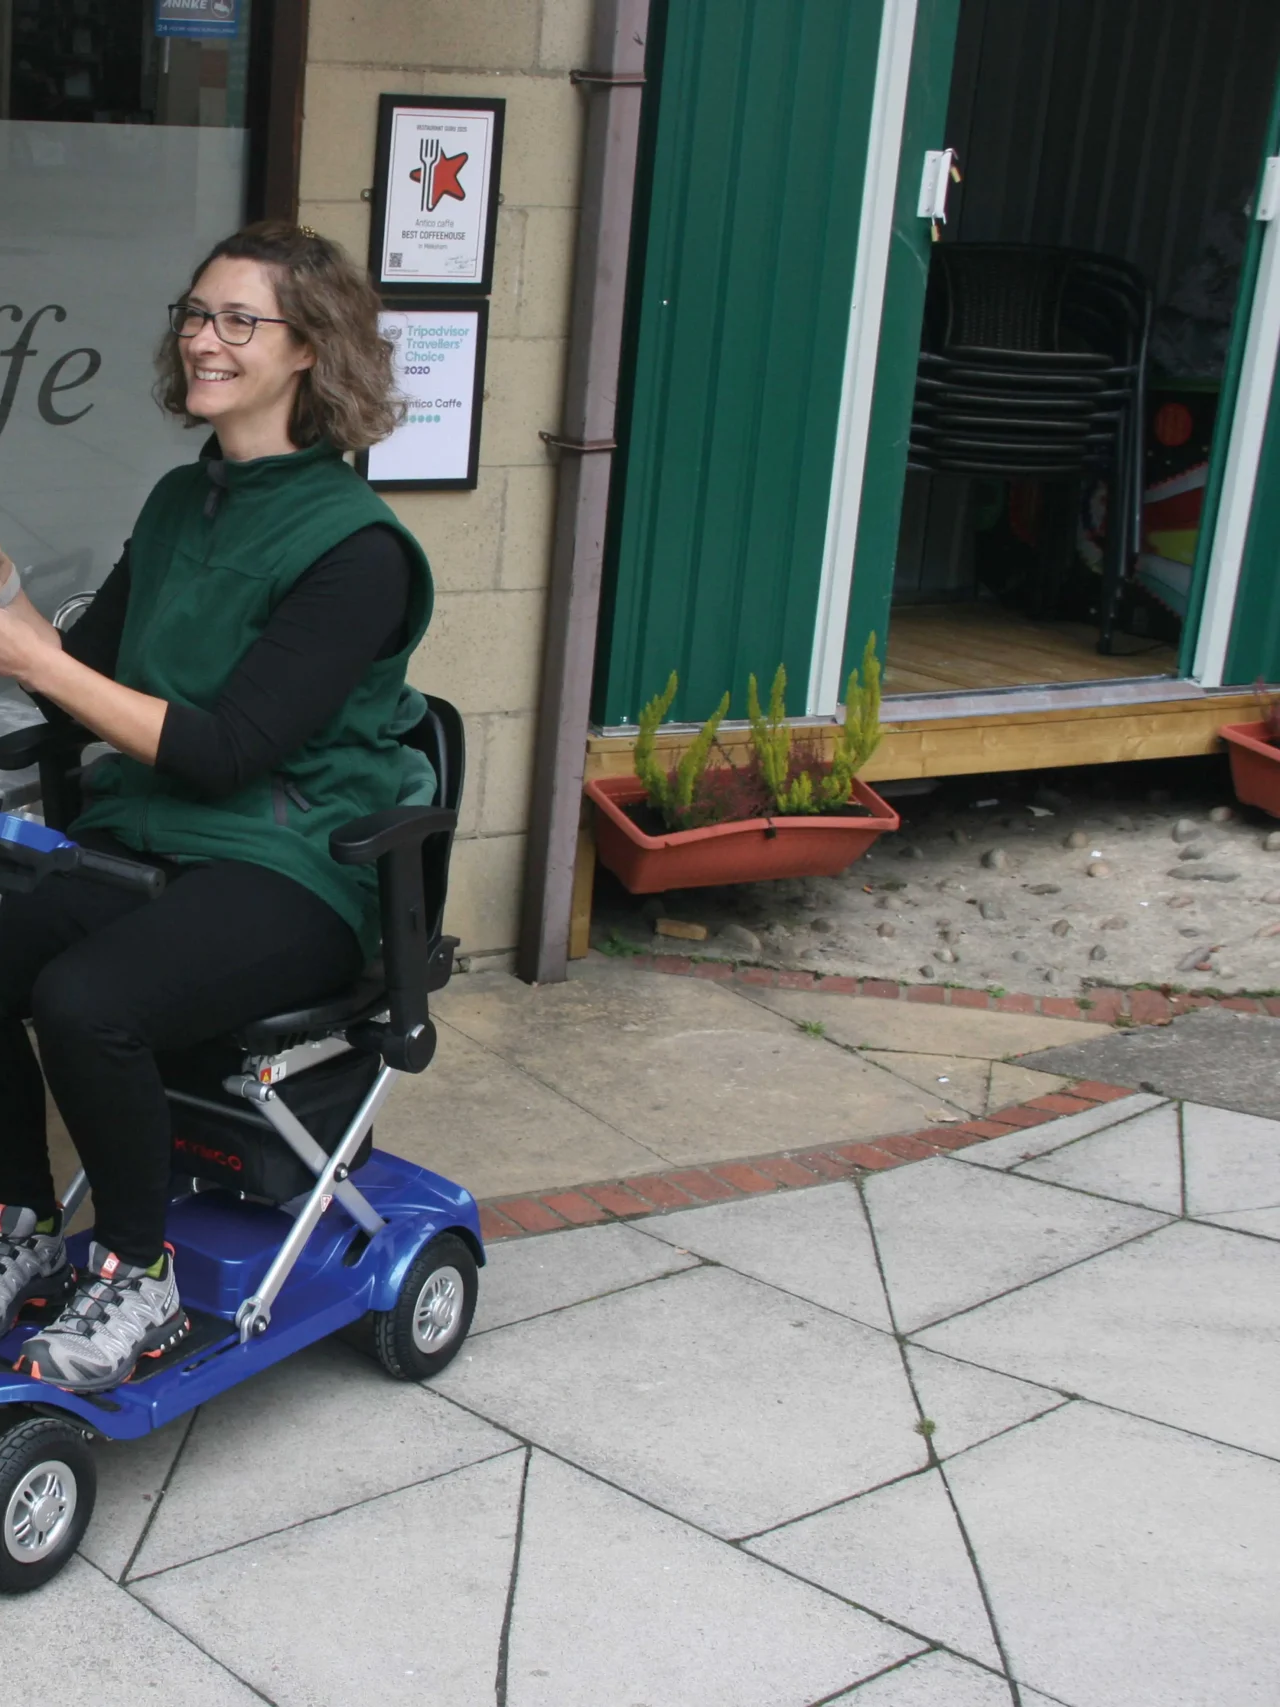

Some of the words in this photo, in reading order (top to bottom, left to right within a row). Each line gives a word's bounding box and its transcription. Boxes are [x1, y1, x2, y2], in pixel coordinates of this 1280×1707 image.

[401, 230, 419, 240] BEST
[420, 231, 466, 241] COFFEEHOUSE
[407, 325, 470, 339] Tripadvisor
[406, 338, 463, 349] Travellers'
[405, 351, 445, 362] Choice
[404, 366, 430, 375] 2020
[435, 399, 462, 408] Caffe
